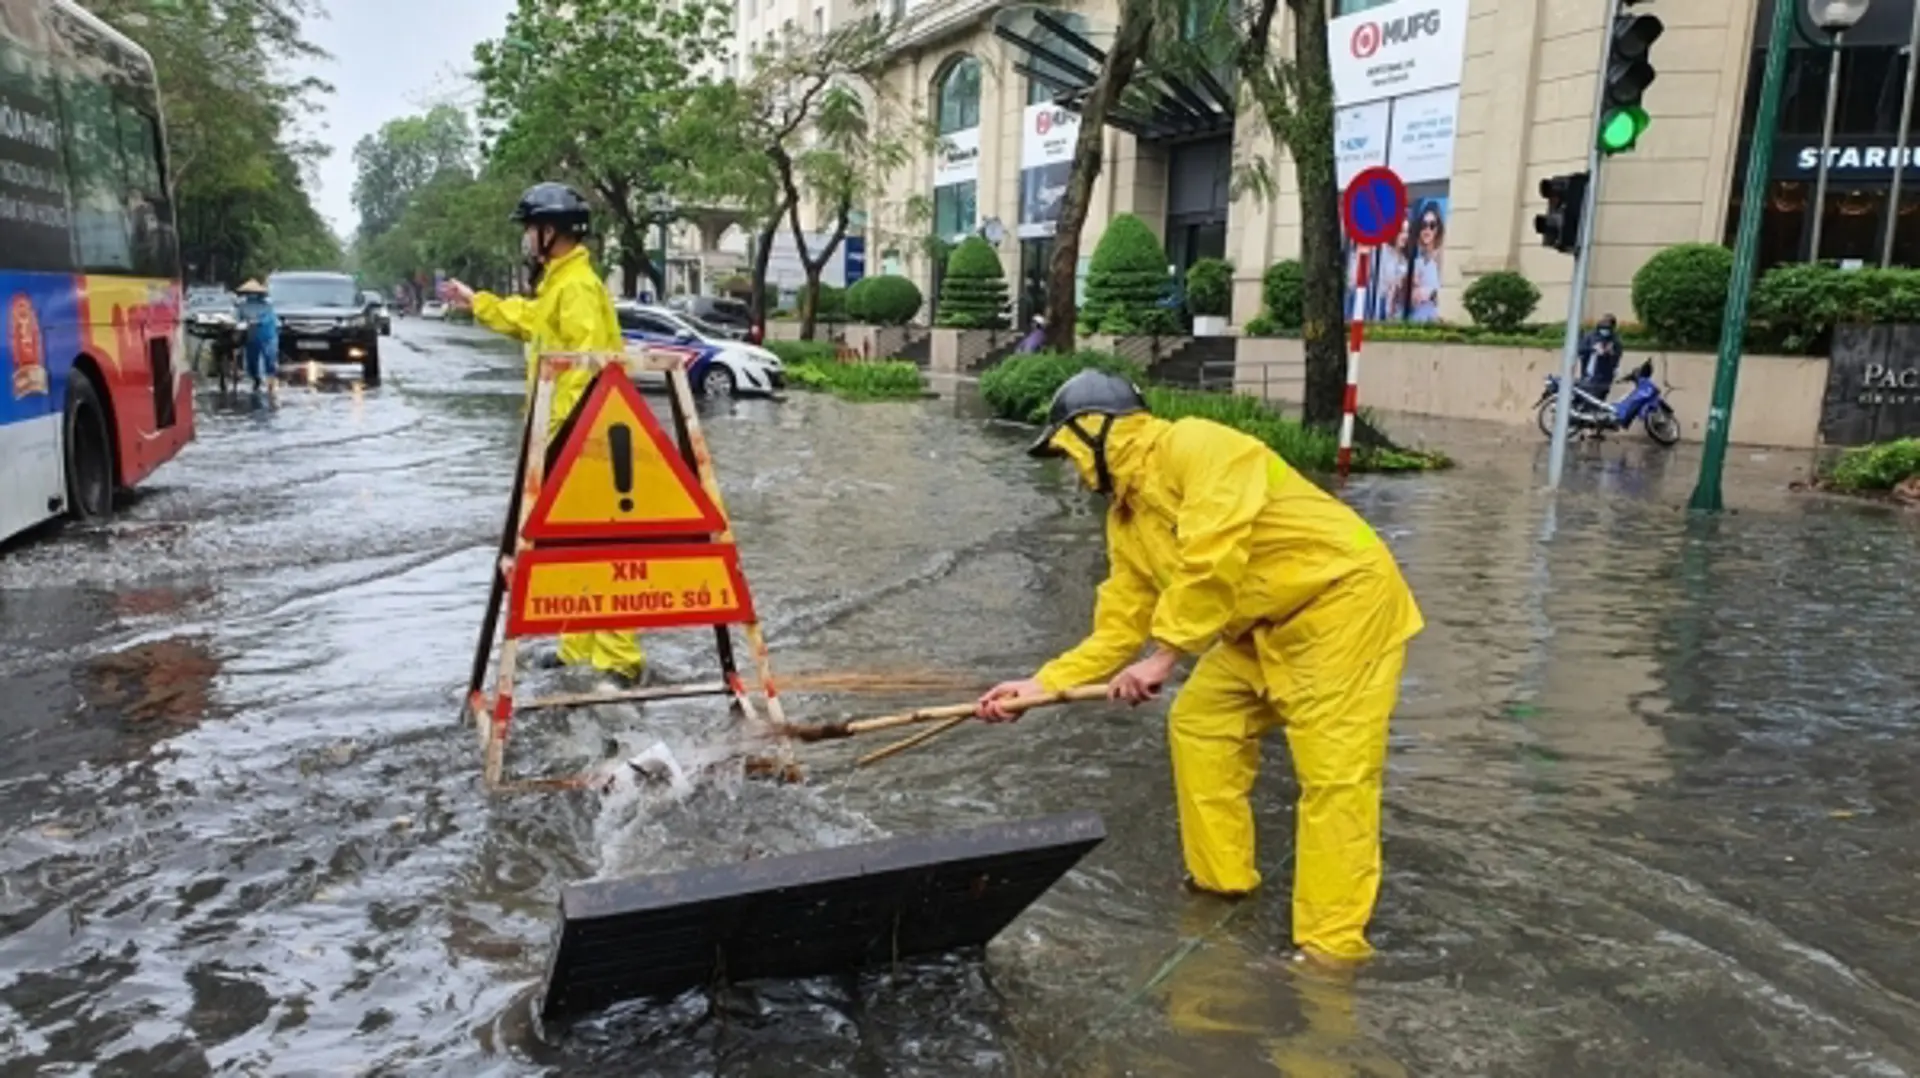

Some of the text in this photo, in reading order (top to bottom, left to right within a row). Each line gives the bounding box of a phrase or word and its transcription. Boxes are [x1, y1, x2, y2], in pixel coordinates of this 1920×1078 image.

[1382, 9, 1440, 46] MUFG
[612, 561, 648, 581] XN
[531, 585, 604, 614] THOÁT
[719, 588, 729, 605] 1
